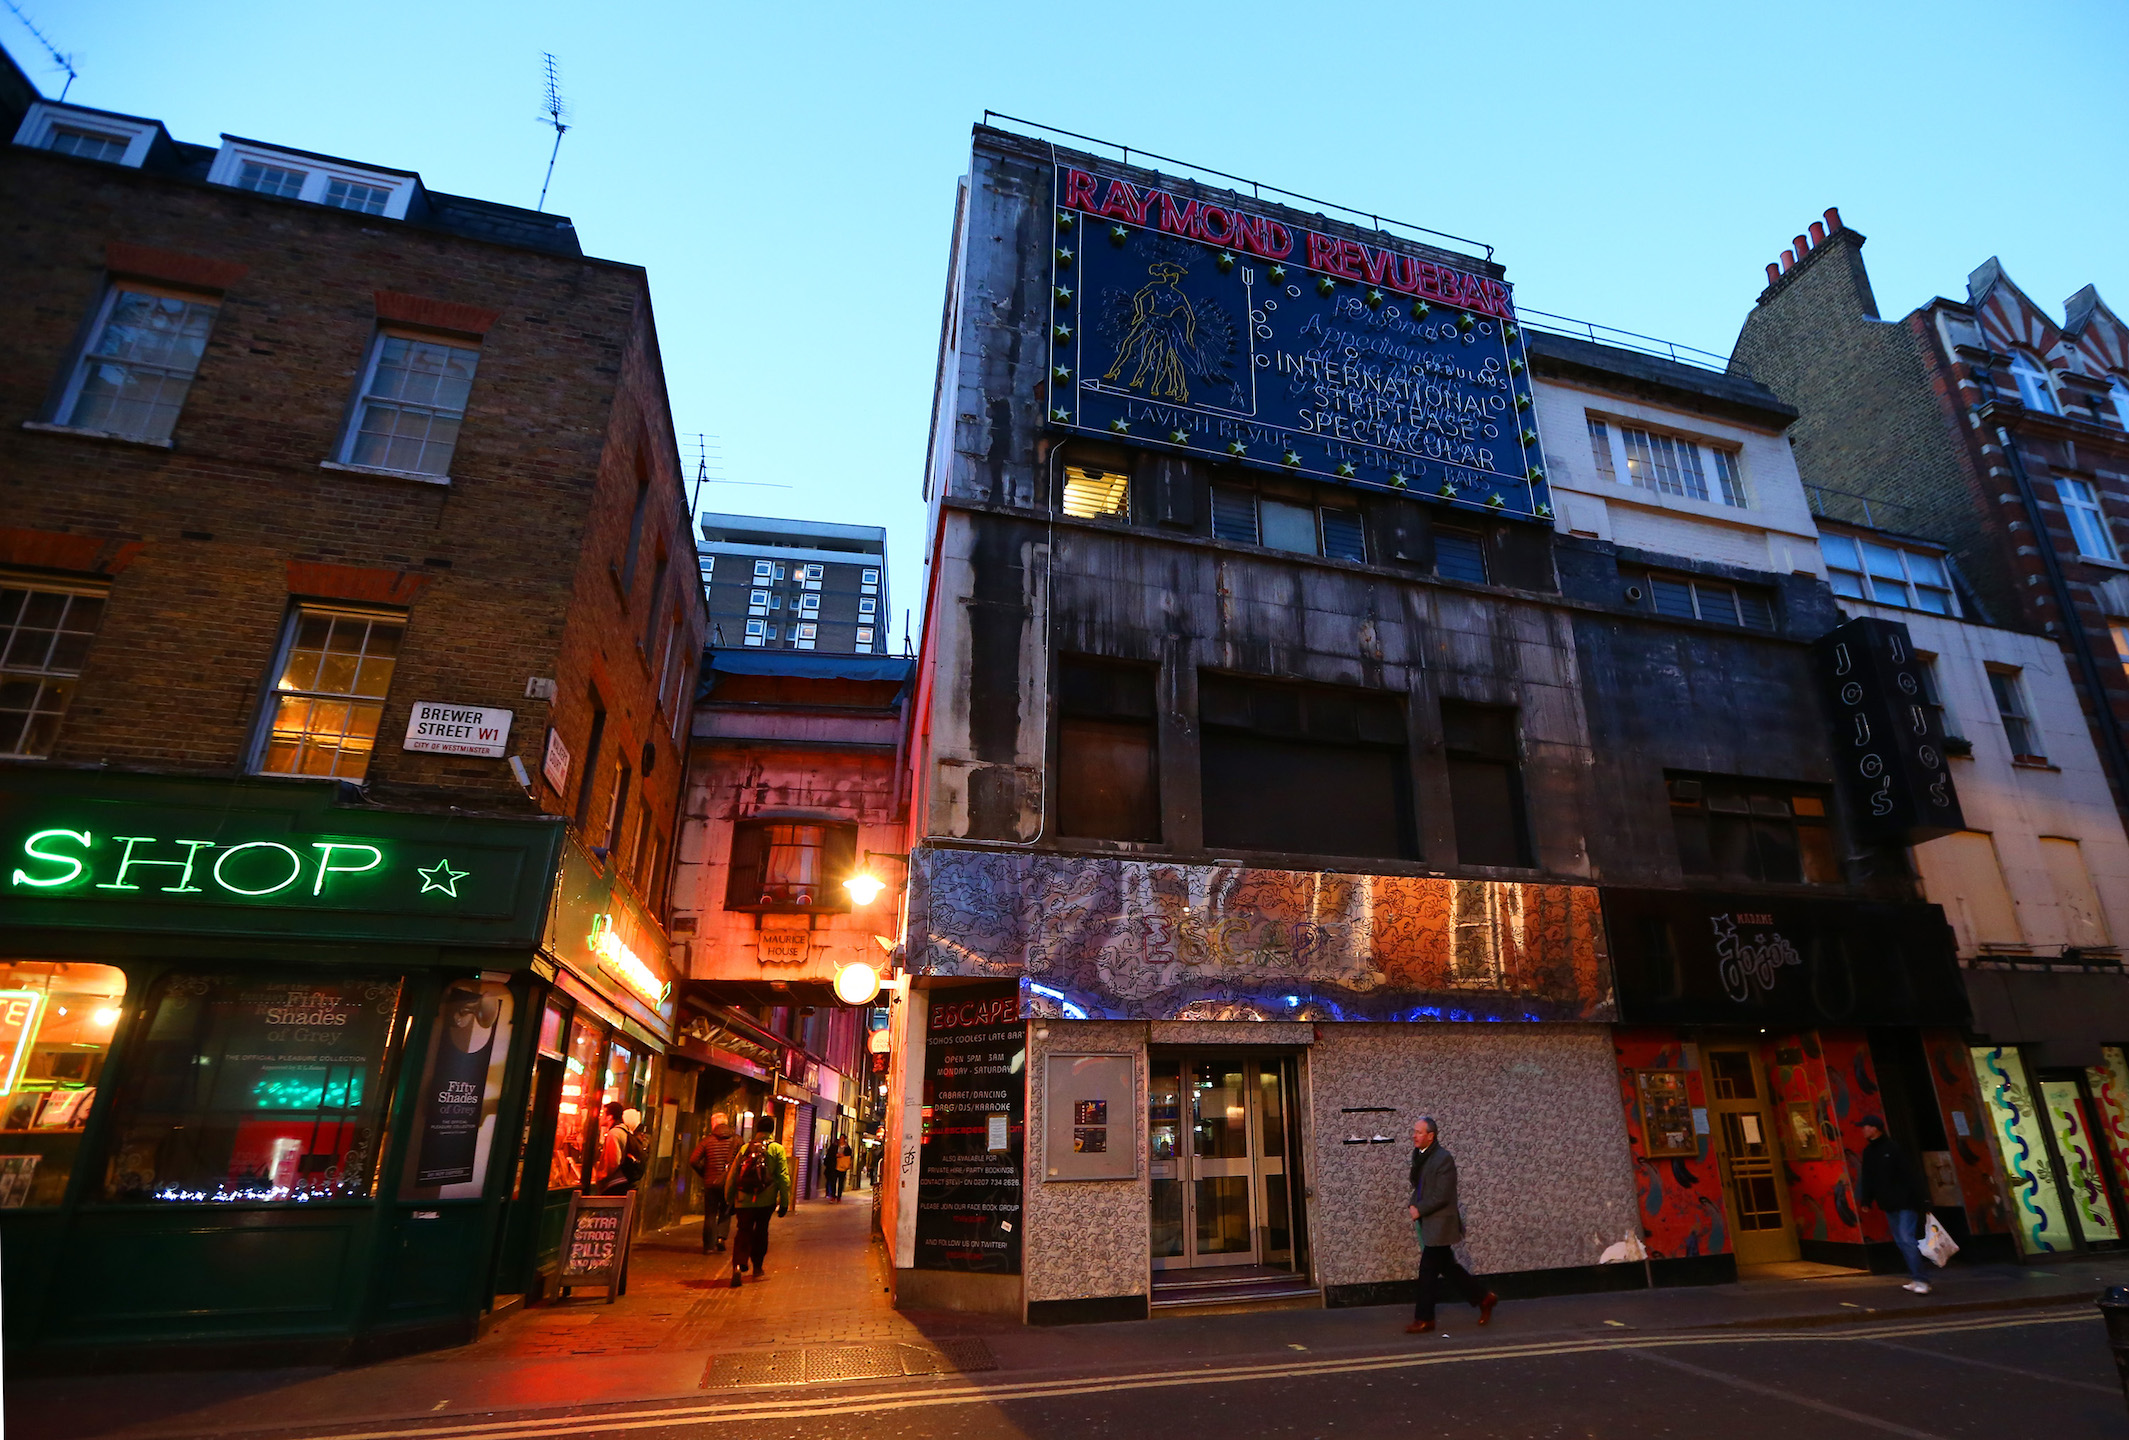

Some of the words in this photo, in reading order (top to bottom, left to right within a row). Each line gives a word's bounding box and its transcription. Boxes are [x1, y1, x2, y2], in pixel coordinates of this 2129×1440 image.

[1065, 168, 1294, 260] RAYMOND
[1307, 231, 1515, 320] REVUEBAR
[1300, 314, 1455, 371] Appearances
[1426, 361, 1508, 389] FABULOUS
[1277, 350, 1497, 420] INTERNATIONAL
[1315, 386, 1475, 441] STRIPTEASE
[1128, 401, 1210, 433] LAVISH
[1219, 420, 1293, 452] REVUE
[1325, 442, 1427, 476] LICENSED
[1444, 466, 1491, 491] BARS
[1299, 409, 1496, 471] SPECTACULAR
[420, 707, 483, 724] BREWER
[417, 722, 473, 738] STREET
[478, 728, 499, 741] W1
[1835, 643, 1893, 816] JOJO'S
[413, 741, 428, 749] CITY
[442, 743, 490, 754] WESTMINSTER
[12, 828, 382, 896] SHOP
[1736, 913, 1774, 925] MADAME
[762, 934, 806, 945] MAURICE
[767, 946, 798, 957] HOUSE
[285, 991, 343, 1012] Fifty
[265, 1008, 347, 1026] Shades
[267, 1028, 289, 1042] of
[294, 1028, 342, 1045] Grey
[955, 1033, 986, 1044] COOLEST
[988, 1032, 1005, 1041] LATE
[944, 1055, 964, 1064] OPEN
[967, 1054, 982, 1063] 5PM
[988, 1053, 1005, 1062] 3AM
[937, 1067, 968, 1076] MONDAY
[974, 1065, 1012, 1075] SATURDAY
[448, 1081, 476, 1095] Fifty
[938, 1090, 1008, 1100] CABARET/DANCING
[438, 1092, 478, 1104] Shades
[440, 1105, 450, 1114] of
[453, 1105, 476, 1116] Grey
[934, 1102, 1011, 1112] DRAG/DJS/KARAOKE
[999, 1204, 1020, 1212] GROUP
[578, 1217, 617, 1229] EXTRA
[574, 1231, 615, 1240] STRONG
[571, 1242, 613, 1257] PILLS
